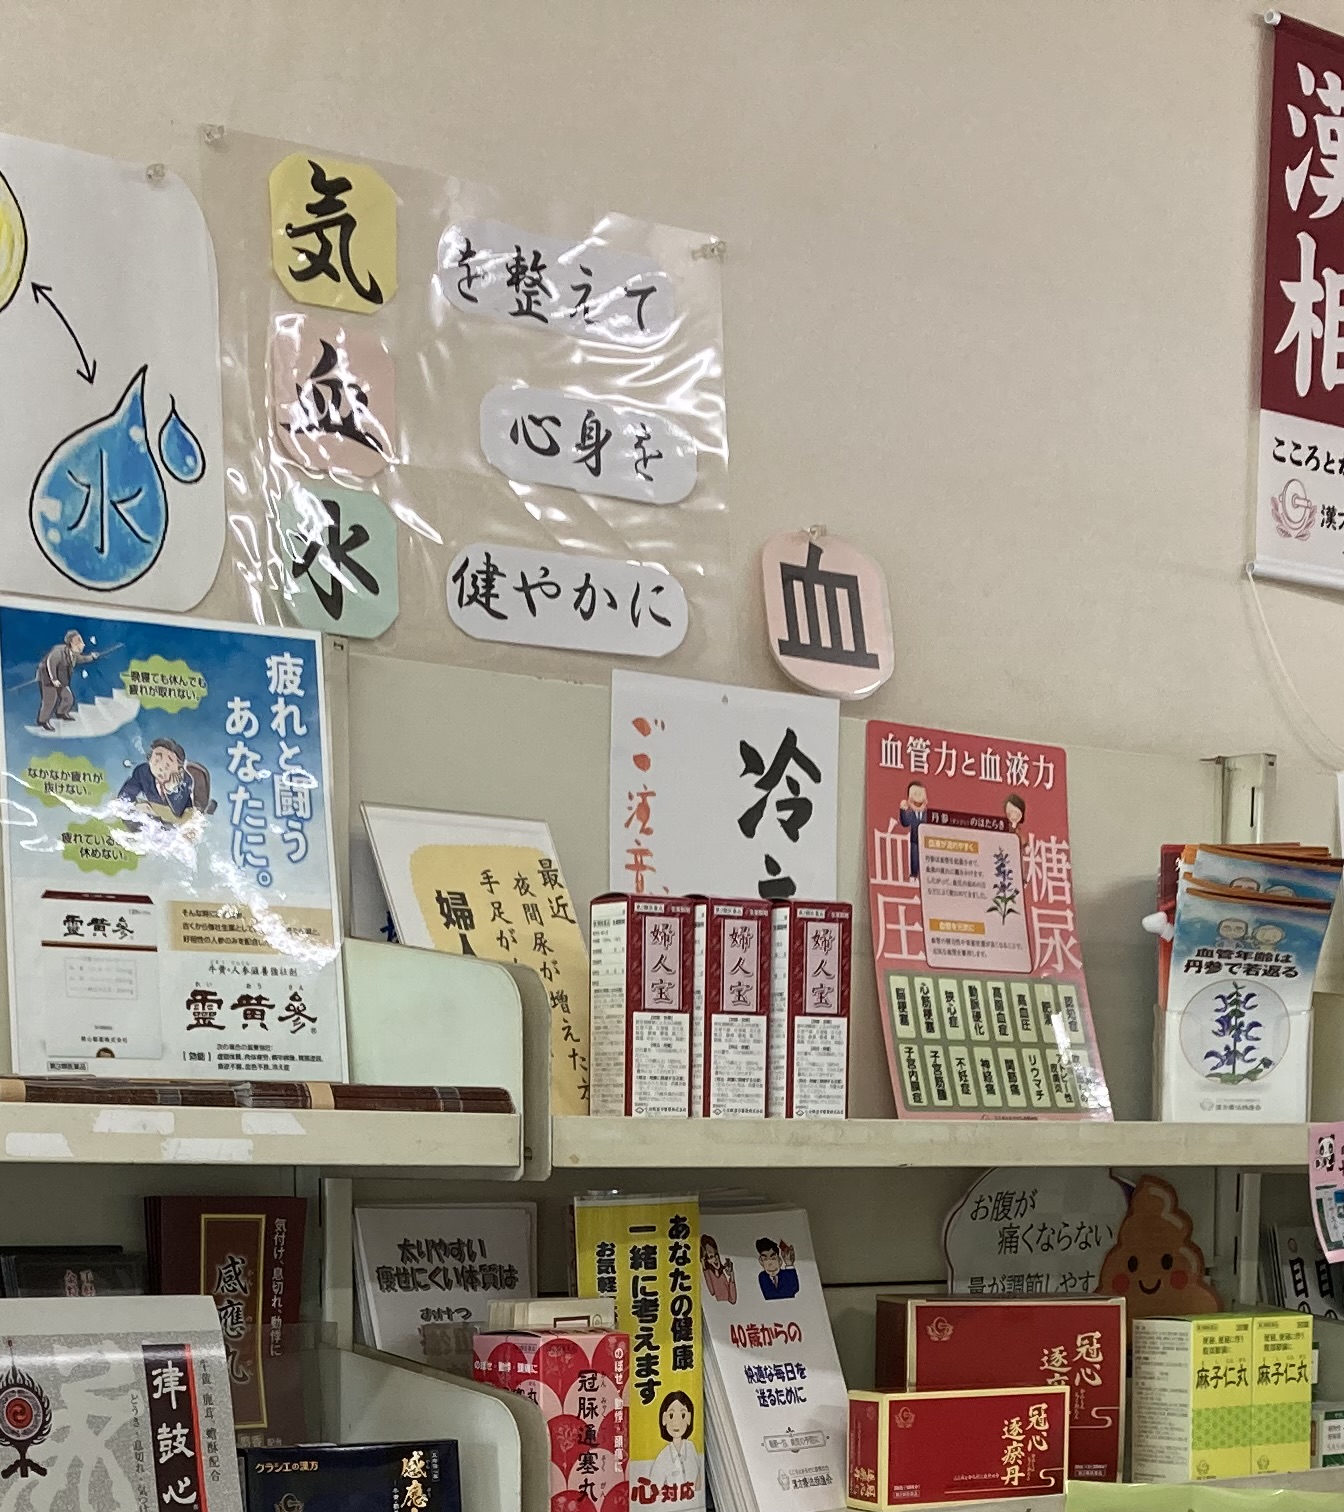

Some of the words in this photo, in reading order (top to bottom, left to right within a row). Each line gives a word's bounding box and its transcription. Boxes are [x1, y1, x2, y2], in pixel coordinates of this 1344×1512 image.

[286, 159, 383, 304] 気
[458, 238, 657, 330] を整えて
[279, 339, 383, 452] 血
[510, 410, 662, 481] 心身を
[68, 450, 149, 553] 水
[293, 501, 380, 620] 水
[452, 552, 671, 627] 健やかに
[778, 542, 879, 669] 血
[28, 767, 103, 782] なかなか疲れが
[266, 651, 312, 862] 疲れと闘う
[879, 733, 1055, 790] 血管力と血液力
[225, 697, 272, 887] あなたに。
[536, 858, 577, 923] 最近
[869, 817, 926, 960] 血圧
[1022, 832, 1083, 973] 糖尿
[650, 923, 674, 1004] 婦人宝
[729, 926, 754, 1008] 婦人宝
[812, 929, 834, 1010] 婦人宝
[1182, 960, 1299, 979] 丹参で若返る
[1195, 945, 1293, 964] 血管年齢は
[919, 983, 935, 1033] 心筋梗塞
[968, 986, 984, 1035] 動脈硬化
[1017, 994, 1031, 1031] 高血圧
[904, 1046, 923, 1103] 子宮内膜症
[956, 1058, 971, 1095] 不妊症
[1028, 1054, 1045, 1100] リウマチ
[970, 1188, 1037, 1220] お腹が
[398, 1237, 487, 1261] 太りやすい
[998, 1223, 1114, 1255] 痛くならない
[630, 1225, 661, 1404] 一緒に考えます
[667, 1215, 695, 1370] あなたの健康
[731, 1323, 801, 1350] 40歳からの
[745, 1364, 806, 1382] 快適な毎日を
[756, 1386, 806, 1406] 送るために
[1196, 1365, 1249, 1390] 麻子仁丸
[1257, 1361, 1308, 1385] 麻子仁丸
[151, 1360, 197, 1505] 律鼓心
[1025, 1402, 1051, 1454] 冠心
[256, 1462, 318, 1473] クラシエの漢方
[631, 1478, 695, 1501] 心対応
